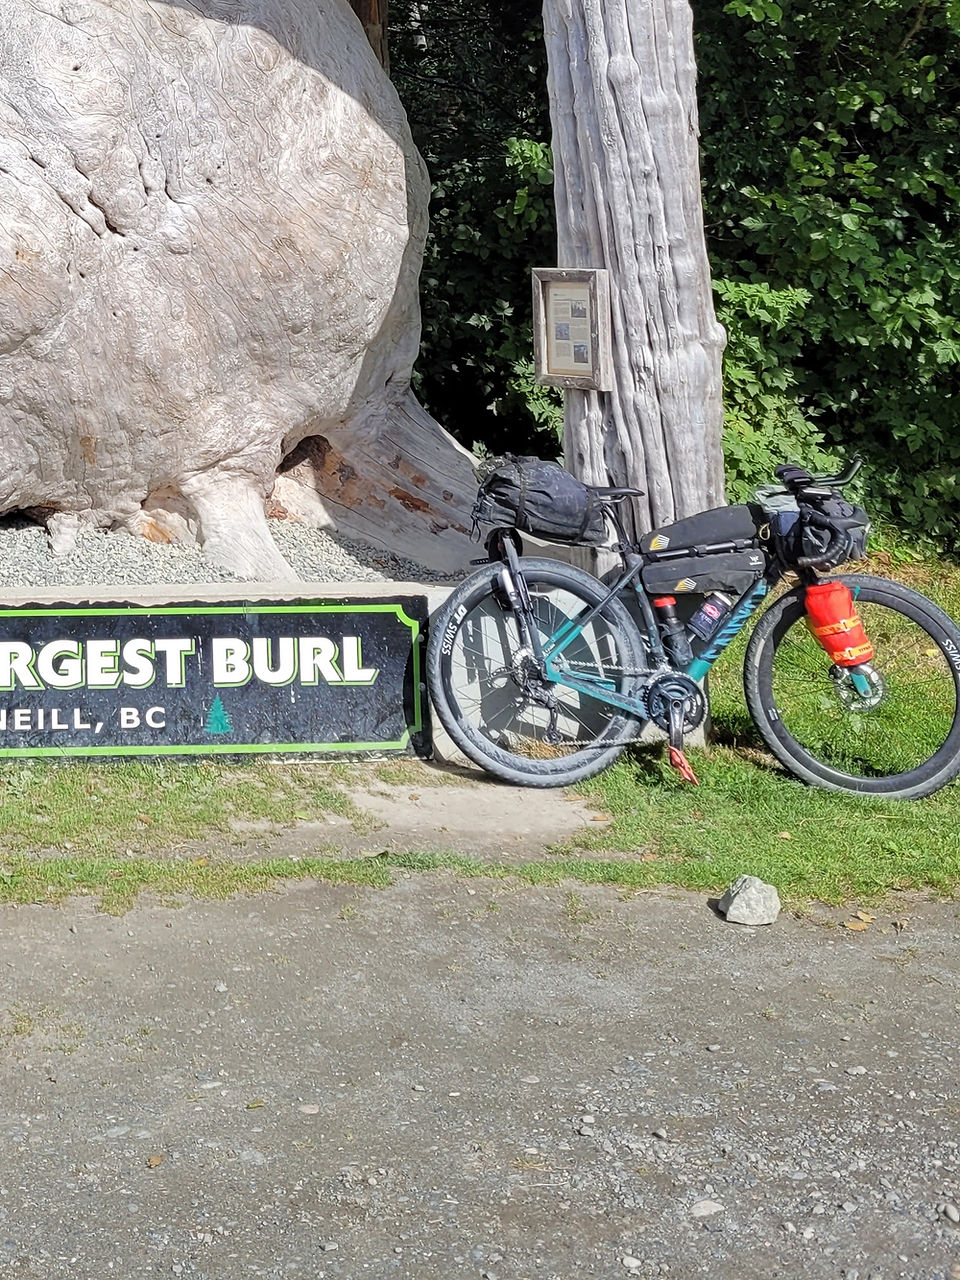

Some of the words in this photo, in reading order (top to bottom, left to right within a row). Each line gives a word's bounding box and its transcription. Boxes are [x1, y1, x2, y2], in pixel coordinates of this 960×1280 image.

[453, 603, 468, 625] DT
[441, 622, 458, 656] SWISS
[212, 636, 378, 687] BURL
[120, 706, 166, 729] BC
